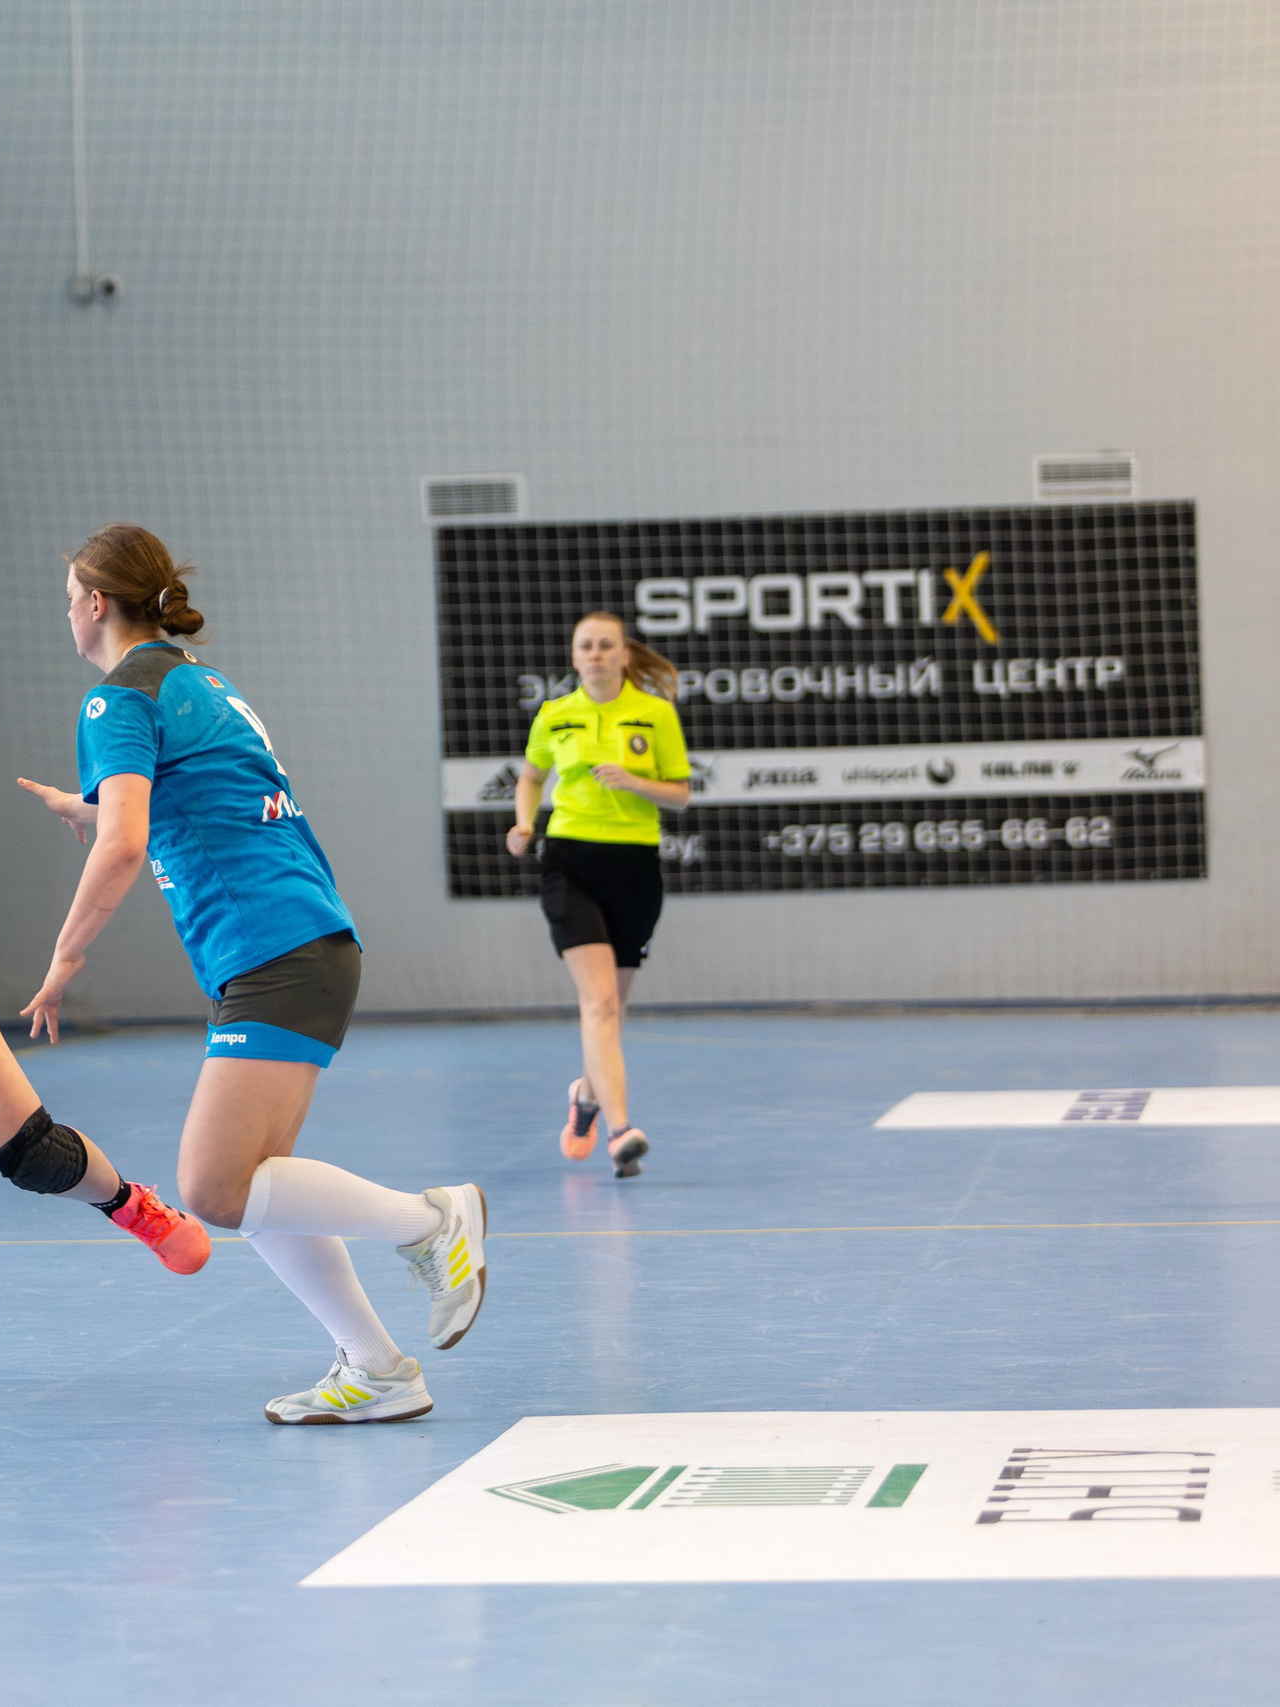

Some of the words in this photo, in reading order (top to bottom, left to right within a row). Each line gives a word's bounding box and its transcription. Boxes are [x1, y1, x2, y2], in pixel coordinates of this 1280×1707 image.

[634, 551, 998, 645] SPORTIX
[517, 656, 943, 709] ЭКРОВОЧНЫЙ
[973, 655, 1126, 699] ЦЕНТР
[764, 823, 852, 856] +375
[858, 821, 910, 854] 29
[914, 815, 1115, 852] 655-66-62
